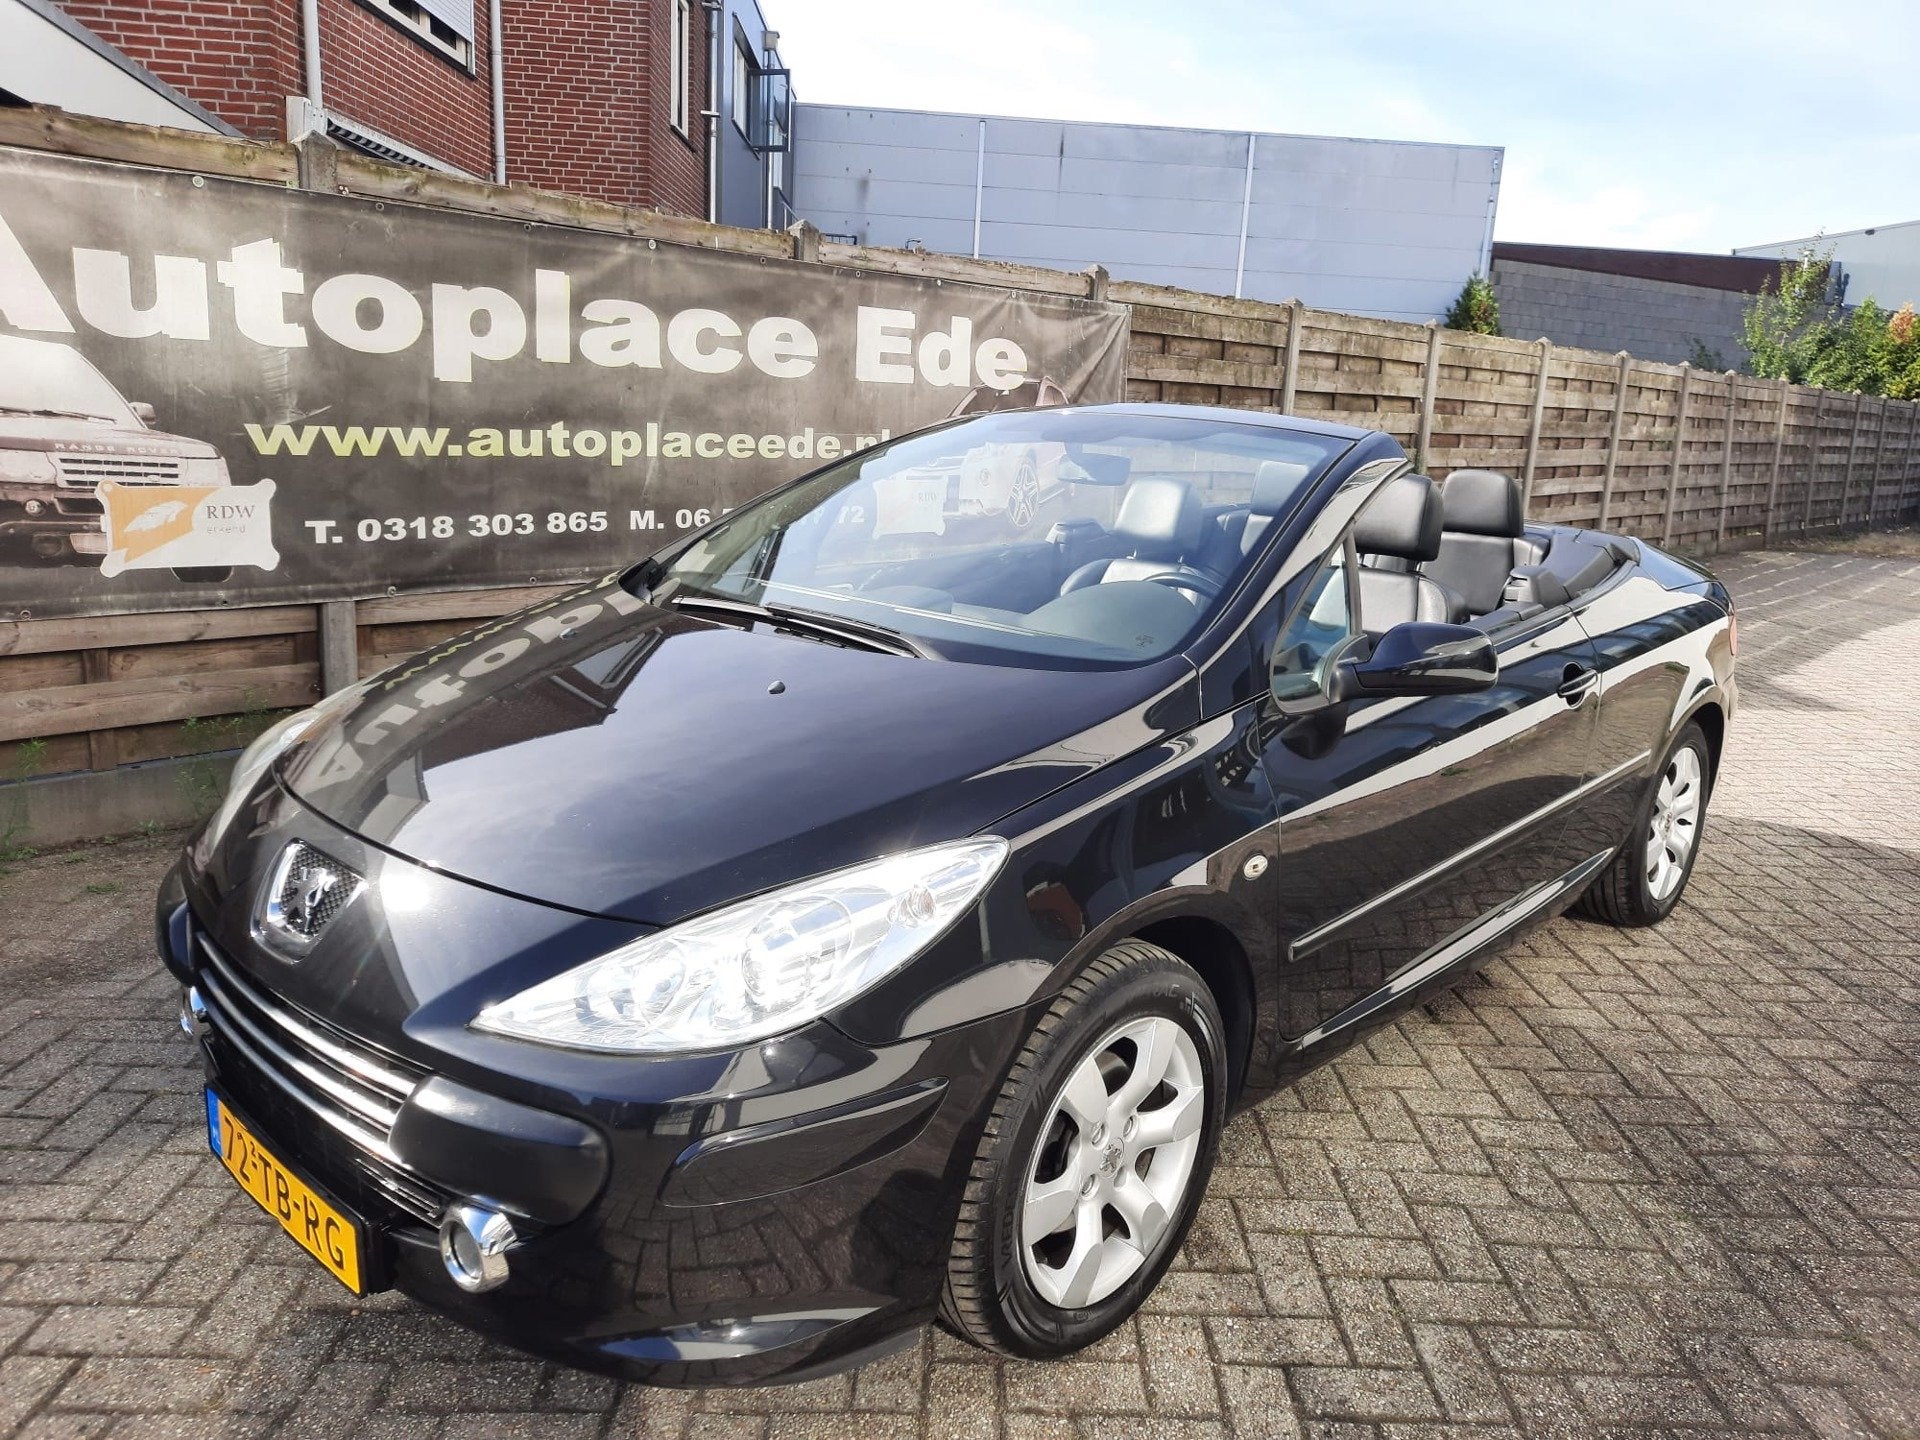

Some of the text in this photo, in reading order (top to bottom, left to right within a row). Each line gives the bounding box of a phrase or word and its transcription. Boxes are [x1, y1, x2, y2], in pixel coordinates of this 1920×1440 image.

[855, 304, 1029, 391] Ede
[206, 504, 256, 520] RDW
[304, 520, 343, 544] T.
[357, 515, 455, 542] 0318
[468, 513, 535, 537] 303
[546, 511, 608, 534] 865
[629, 509, 665, 530] M.
[675, 508, 711, 529] 06
[224, 1115, 345, 1271] 72-TB-RG
